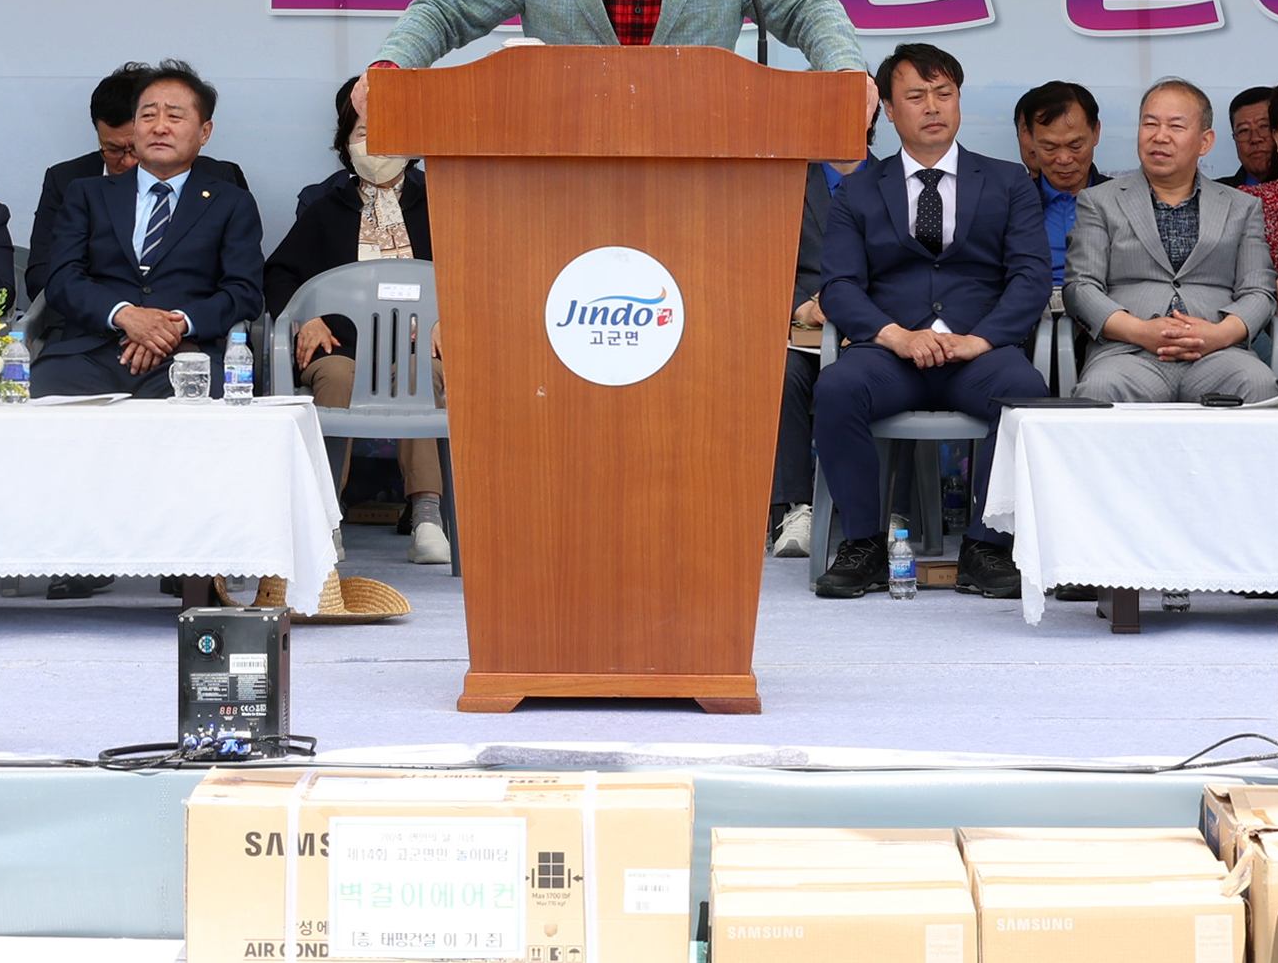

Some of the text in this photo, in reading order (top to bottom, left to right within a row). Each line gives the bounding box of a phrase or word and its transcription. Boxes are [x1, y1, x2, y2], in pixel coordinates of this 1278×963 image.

[555, 299, 654, 328] Jindo
[589, 330, 639, 346] 고군면
[346, 847, 509, 862] 제14회 고군면민 놀이마당
[339, 881, 515, 909] 벽걸이에어컨
[531, 892, 546, 900] Max
[546, 892, 562, 900] 1700
[726, 925, 805, 940] SAMSUNG
[996, 917, 1074, 932] SAMSUNG
[380, 932, 437, 948] 태평건설
[443, 932, 457, 948] 이
[464, 932, 479, 948] 기
[244, 942, 276, 958] AIR
